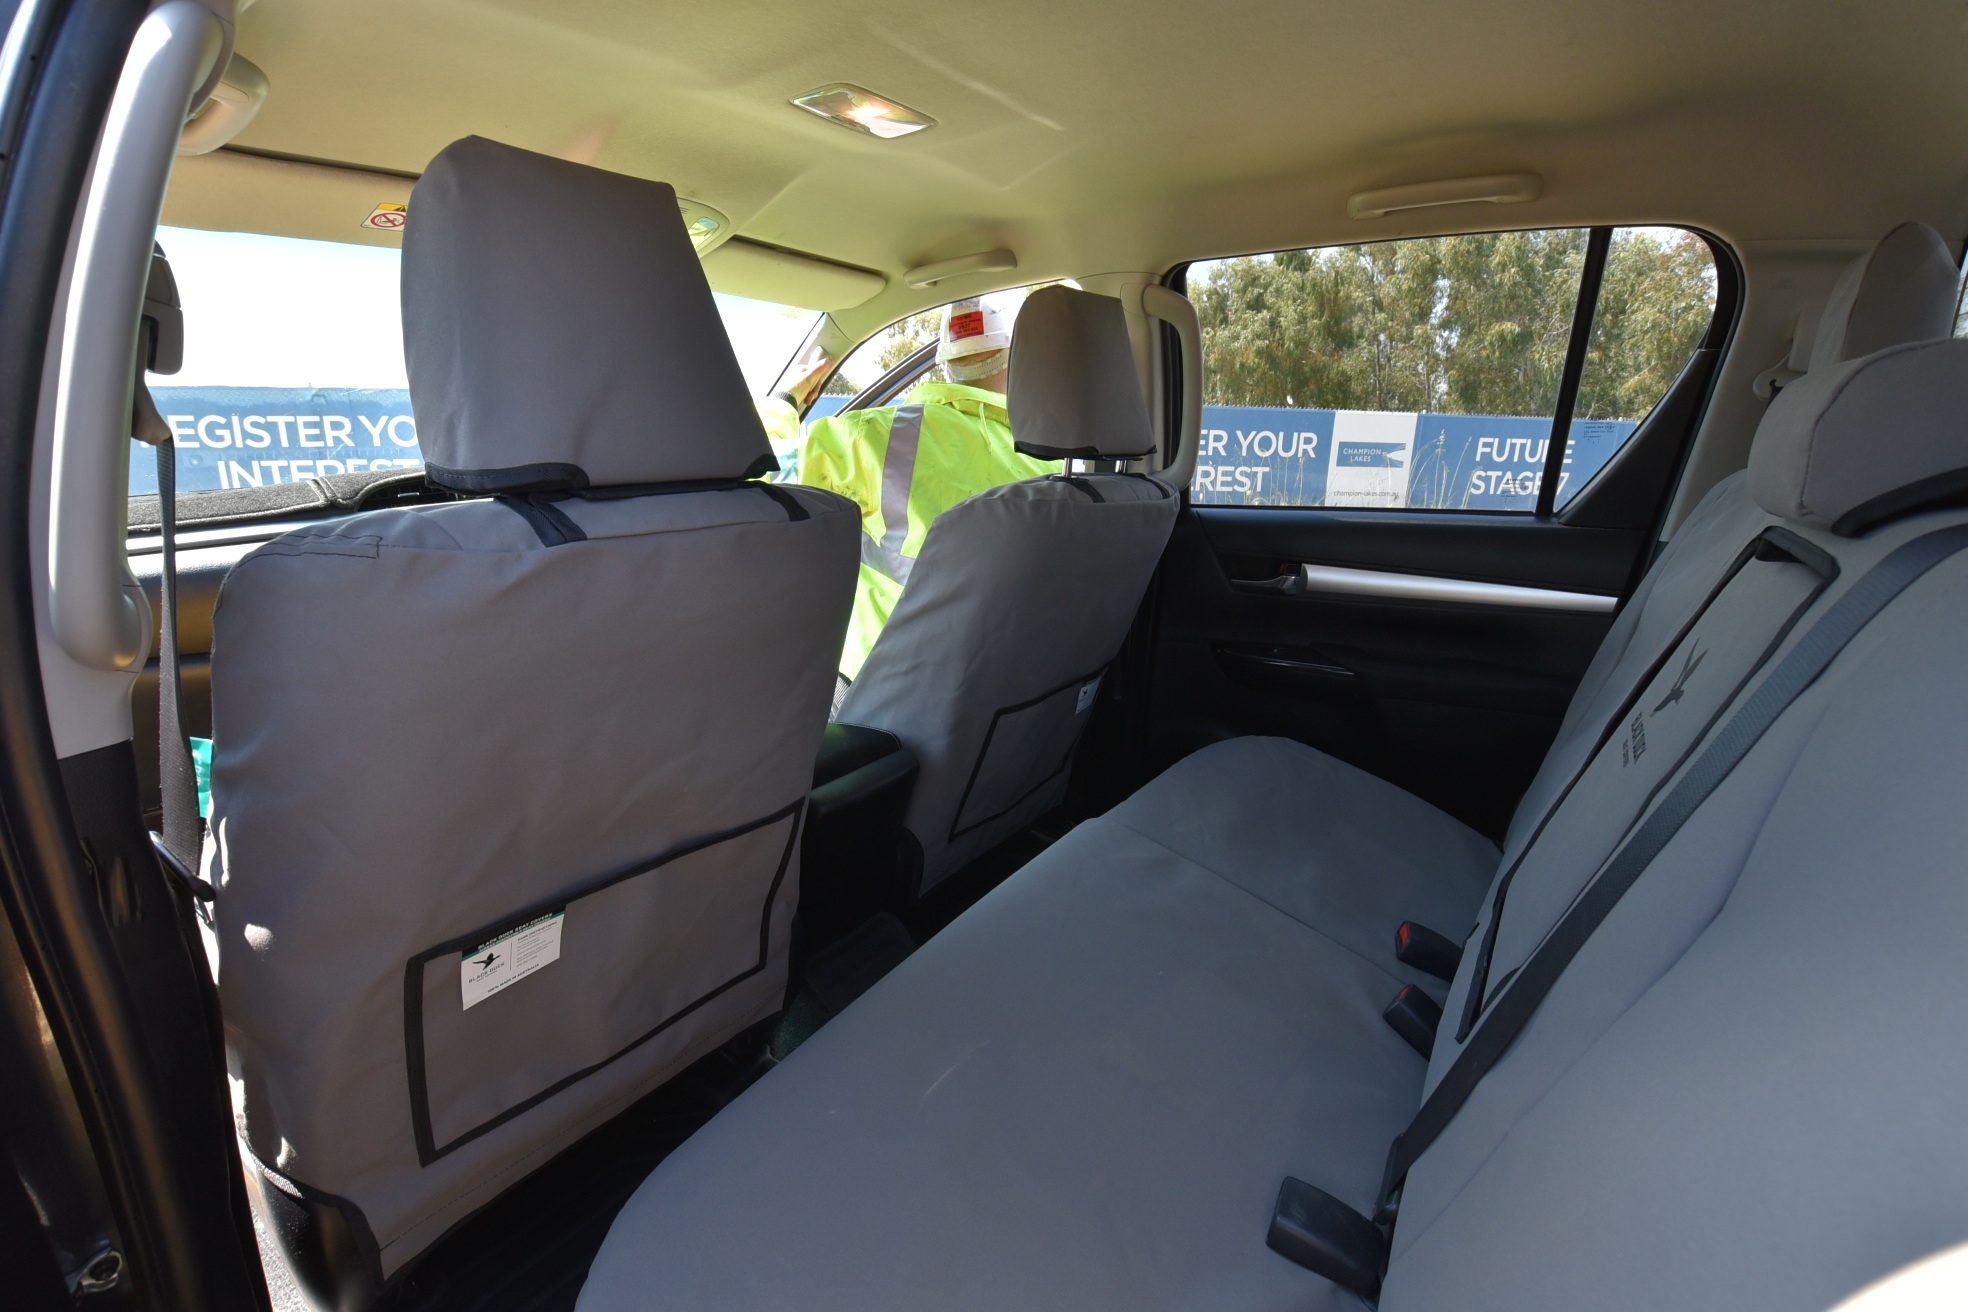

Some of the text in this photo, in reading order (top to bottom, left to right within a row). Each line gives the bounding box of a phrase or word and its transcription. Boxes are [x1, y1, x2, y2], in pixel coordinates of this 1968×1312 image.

[167, 415, 419, 448] EGISTER YO
[1236, 430, 1318, 458] YOUR
[1343, 448, 1381, 456] CHAMPION
[1350, 455, 1371, 463] LAKES
[218, 459, 420, 489] INTE
[1191, 466, 1270, 492] REST
[1556, 472, 1570, 496] 7
[478, 937, 497, 950] BLACK
[498, 929, 514, 939] DUCK
[468, 971, 488, 983] BLACK
[489, 962, 504, 972] DUCK
